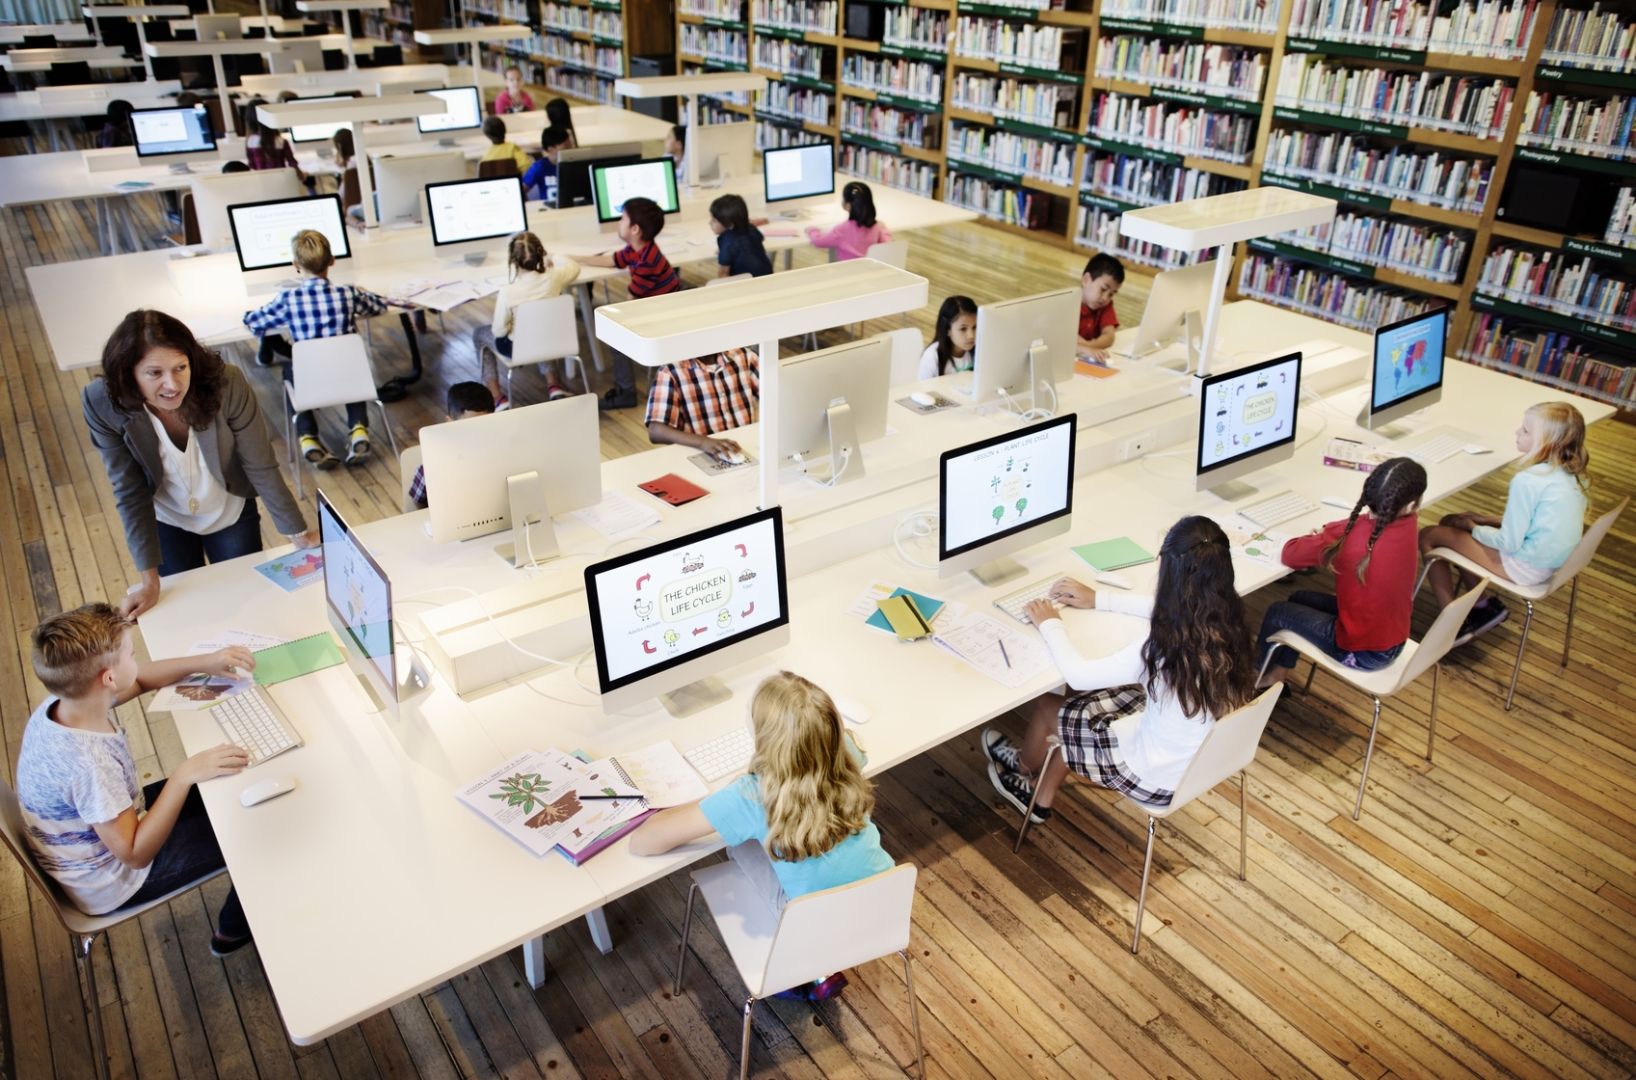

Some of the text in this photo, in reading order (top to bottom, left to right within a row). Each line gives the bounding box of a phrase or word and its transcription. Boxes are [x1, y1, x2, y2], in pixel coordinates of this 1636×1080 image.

[1541, 68, 1563, 79] Poetry
[1520, 149, 1560, 163] Photography
[1568, 241, 1584, 251] Pets
[1591, 245, 1623, 258] Livestock
[664, 574, 726, 603] THE CHICKEN
[671, 590, 723, 616] LIFE CYCLE
